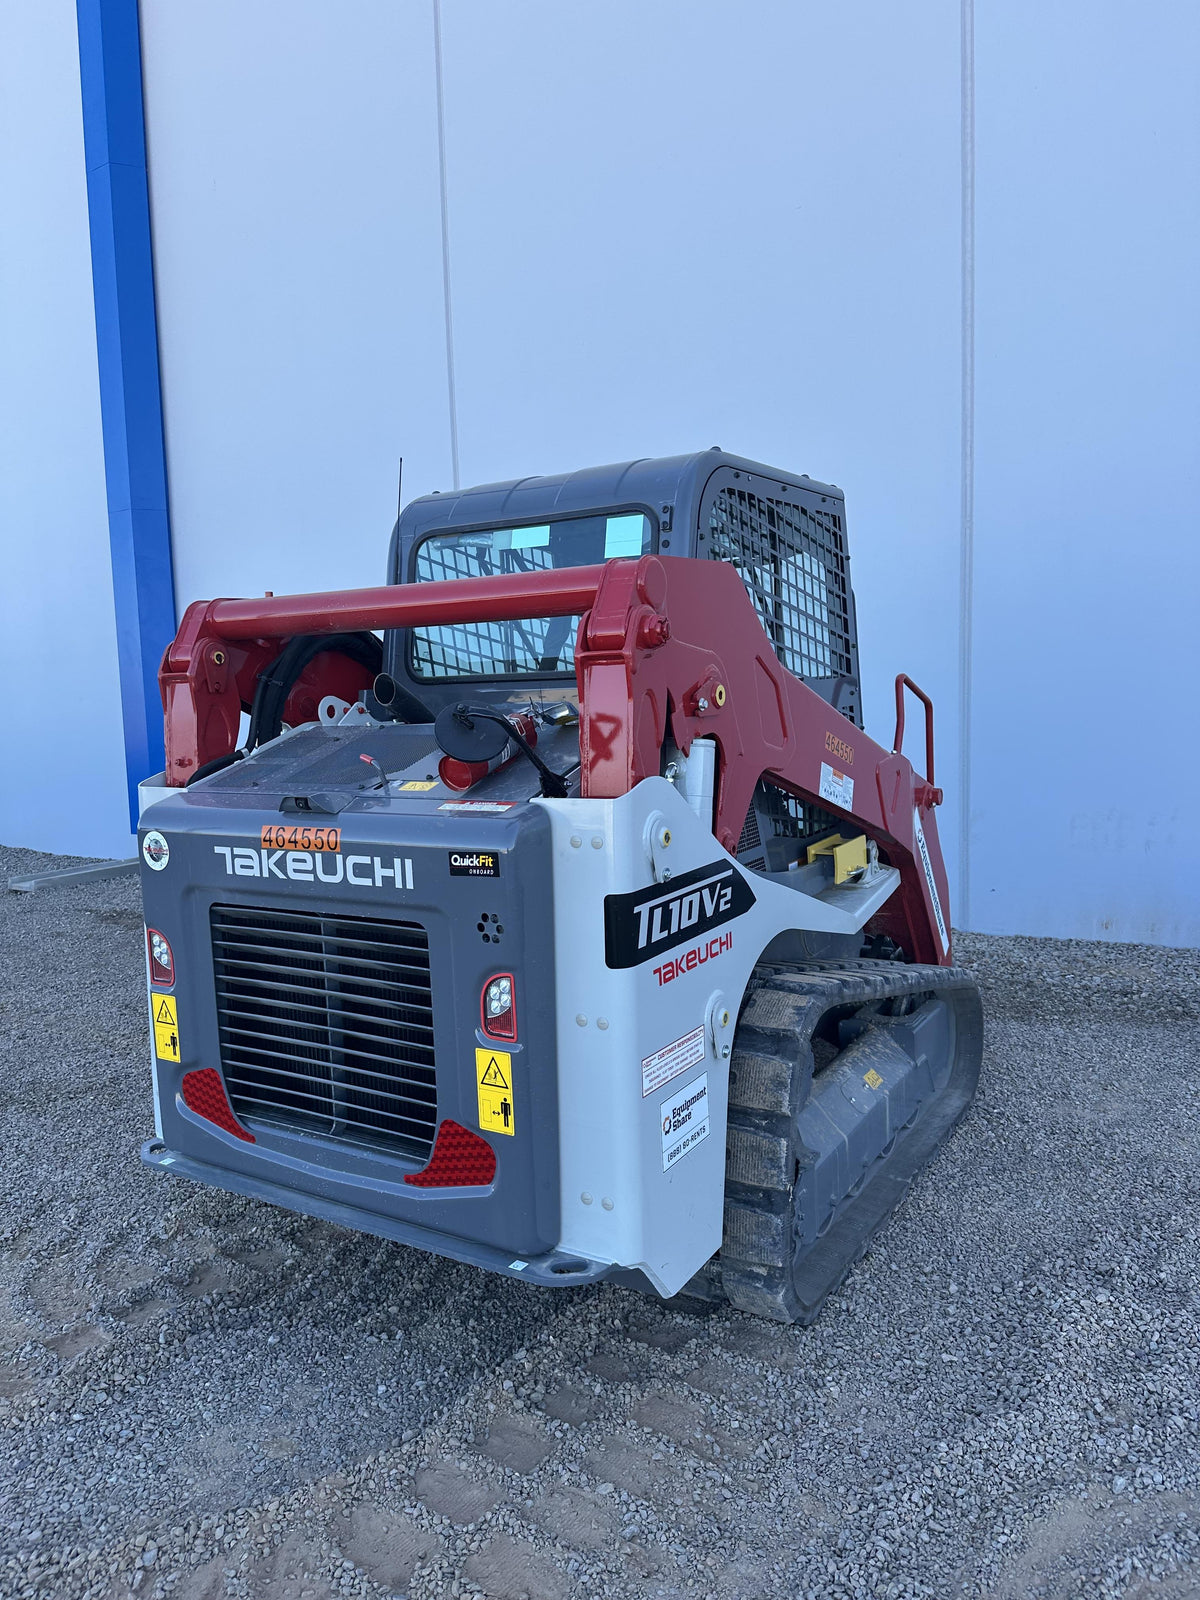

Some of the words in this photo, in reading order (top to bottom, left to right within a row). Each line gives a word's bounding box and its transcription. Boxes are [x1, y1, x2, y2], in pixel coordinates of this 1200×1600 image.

[826, 733, 854, 765] 464550
[262, 826, 340, 851] 464550
[213, 846, 415, 890] TAKEUCHI
[451, 854, 494, 867] QuickFit
[653, 931, 733, 986] TAKEUCHI
[672, 1086, 707, 1119] Equipment
[672, 1111, 692, 1132] Share
